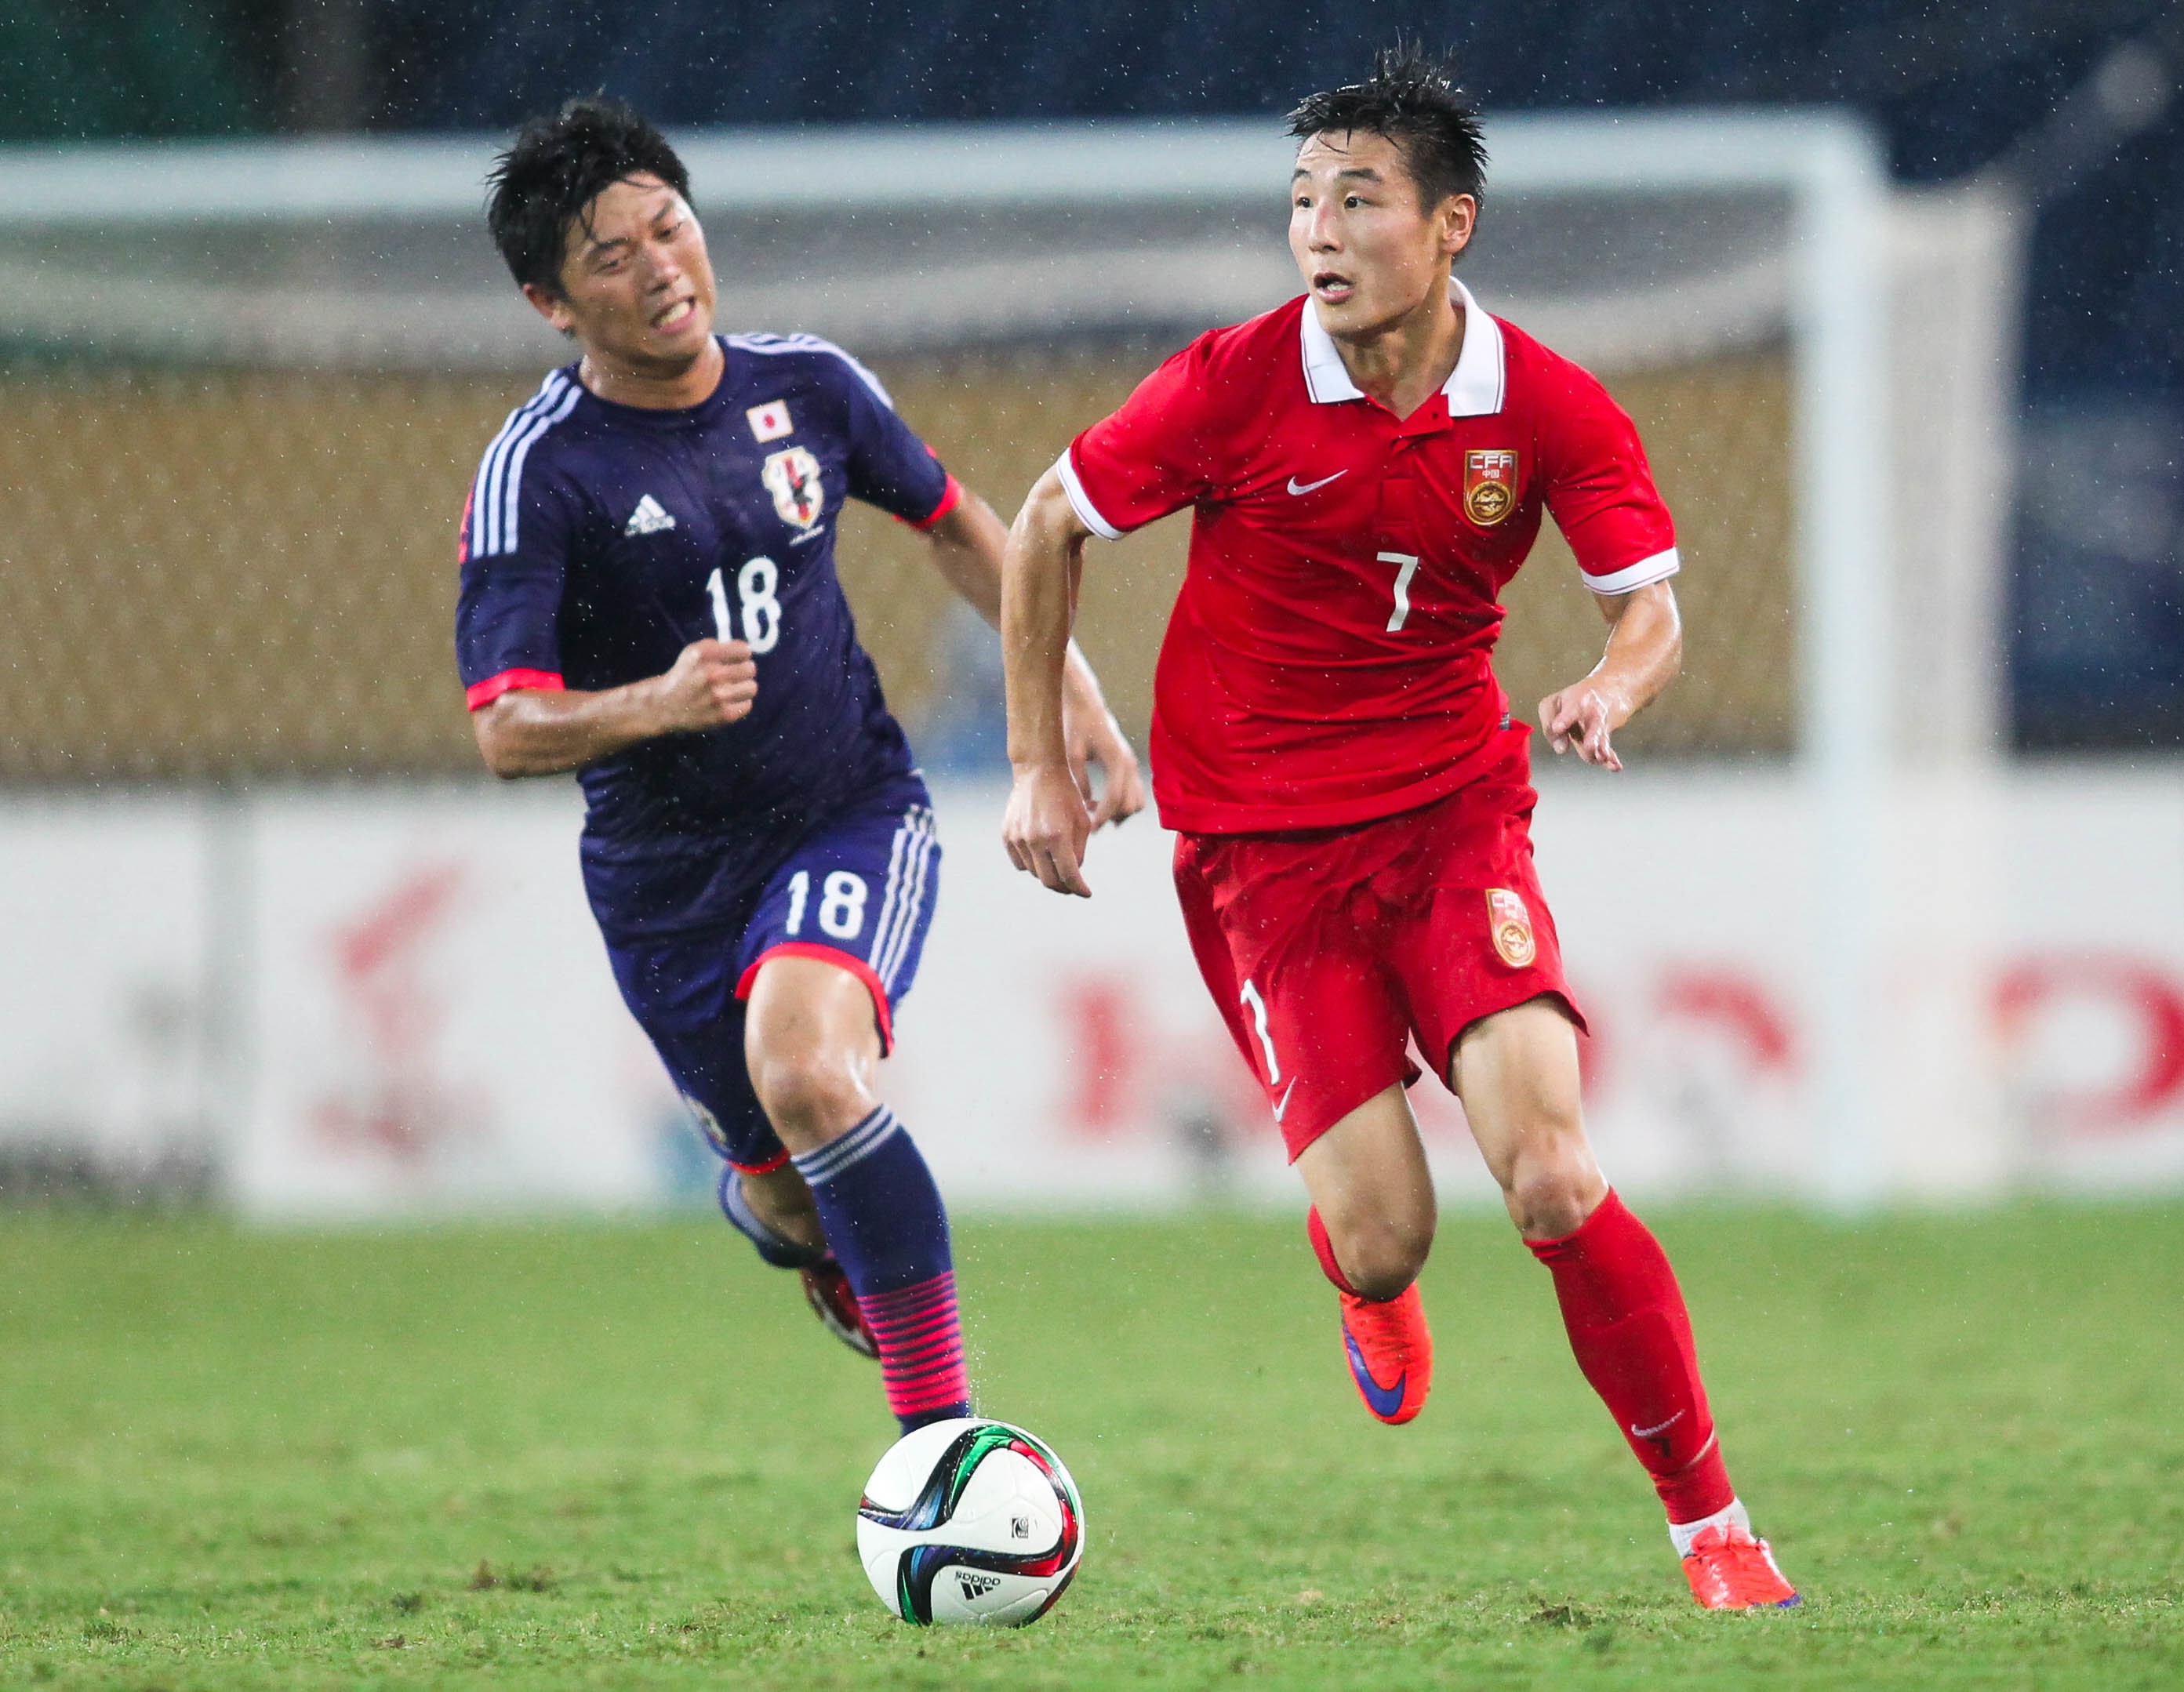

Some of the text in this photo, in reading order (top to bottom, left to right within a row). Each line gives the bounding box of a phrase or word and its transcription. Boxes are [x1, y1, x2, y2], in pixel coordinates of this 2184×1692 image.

[1470, 455, 1513, 469] CFA
[706, 556, 782, 654] 18
[1376, 551, 1419, 632] 7
[786, 870, 869, 940] 18
